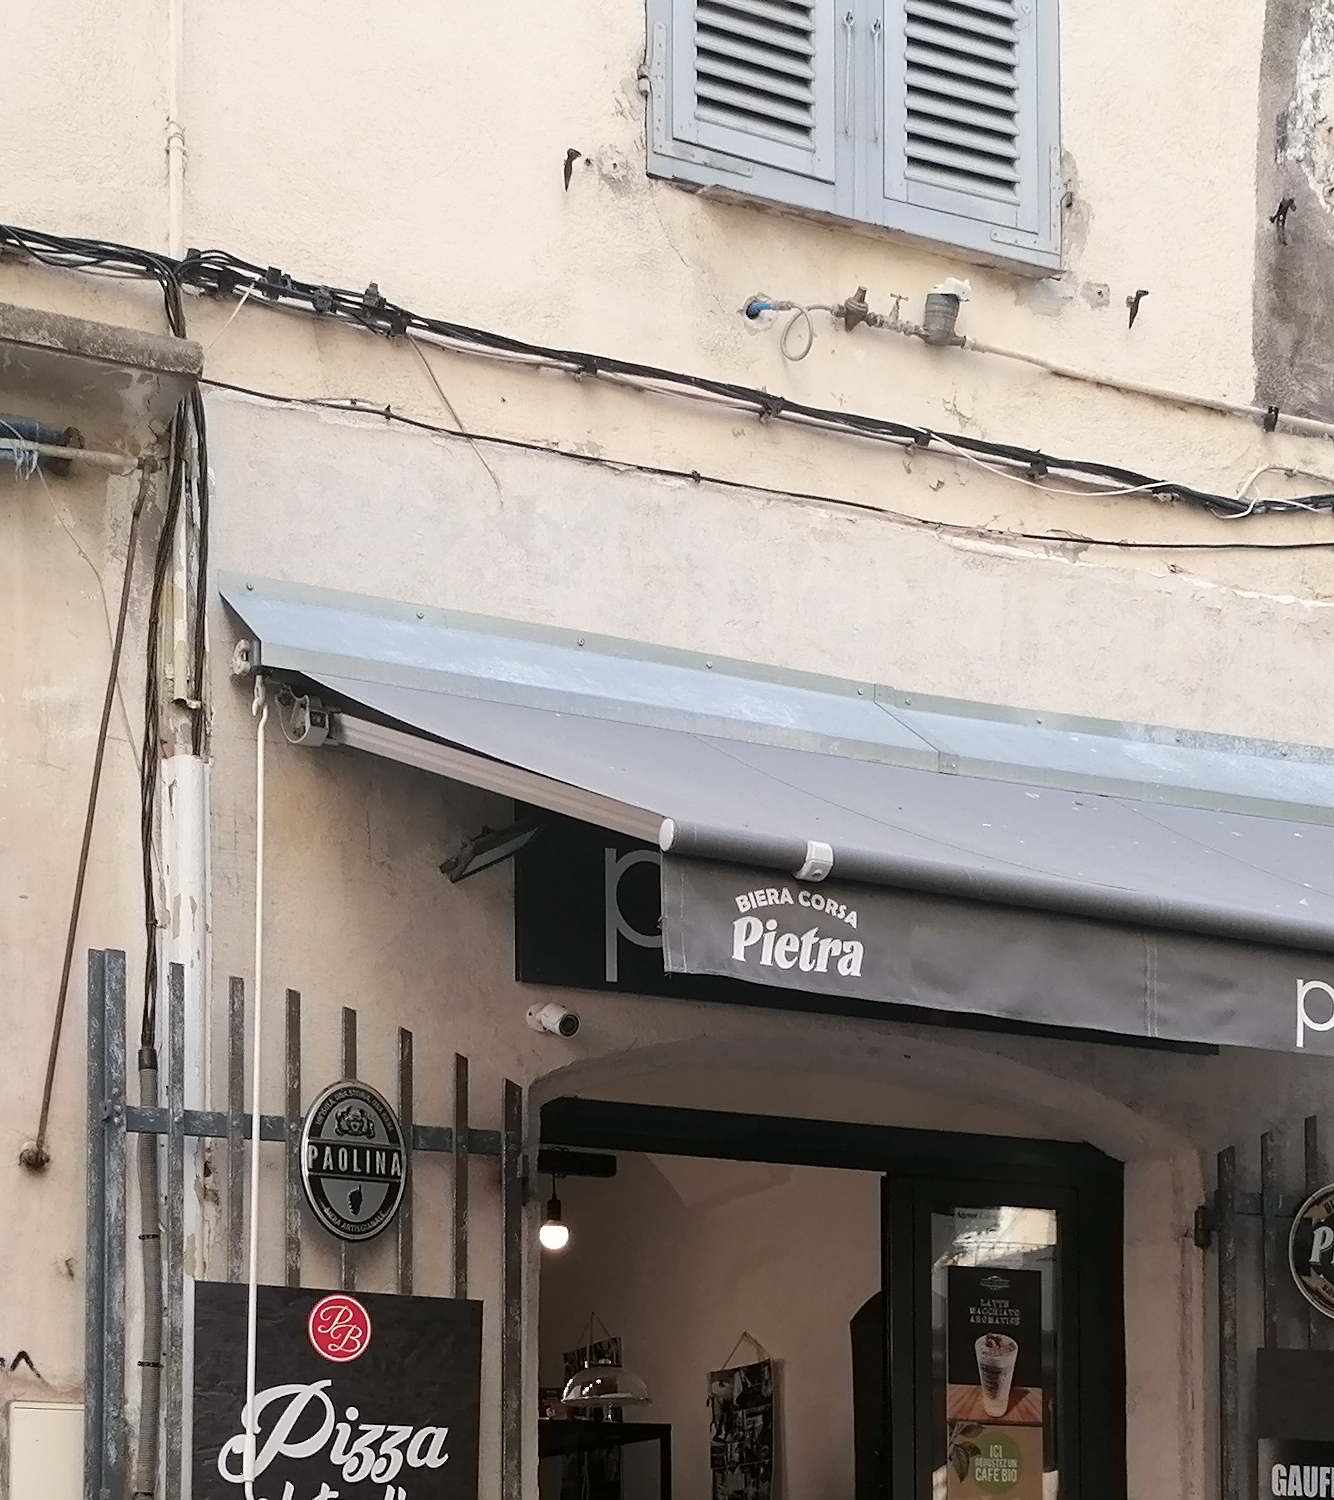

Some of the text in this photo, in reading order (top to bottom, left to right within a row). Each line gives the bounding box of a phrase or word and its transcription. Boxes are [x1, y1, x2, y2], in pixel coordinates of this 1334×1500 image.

[735, 887, 859, 929] BIERA CORSA
[732, 915, 865, 978] Pietra
[307, 1144, 401, 1177] PAOLINA
[218, 1379, 449, 1484] Pizza
[989, 1444, 1003, 1458] ICI
[1001, 1468, 1018, 1483] BIO
